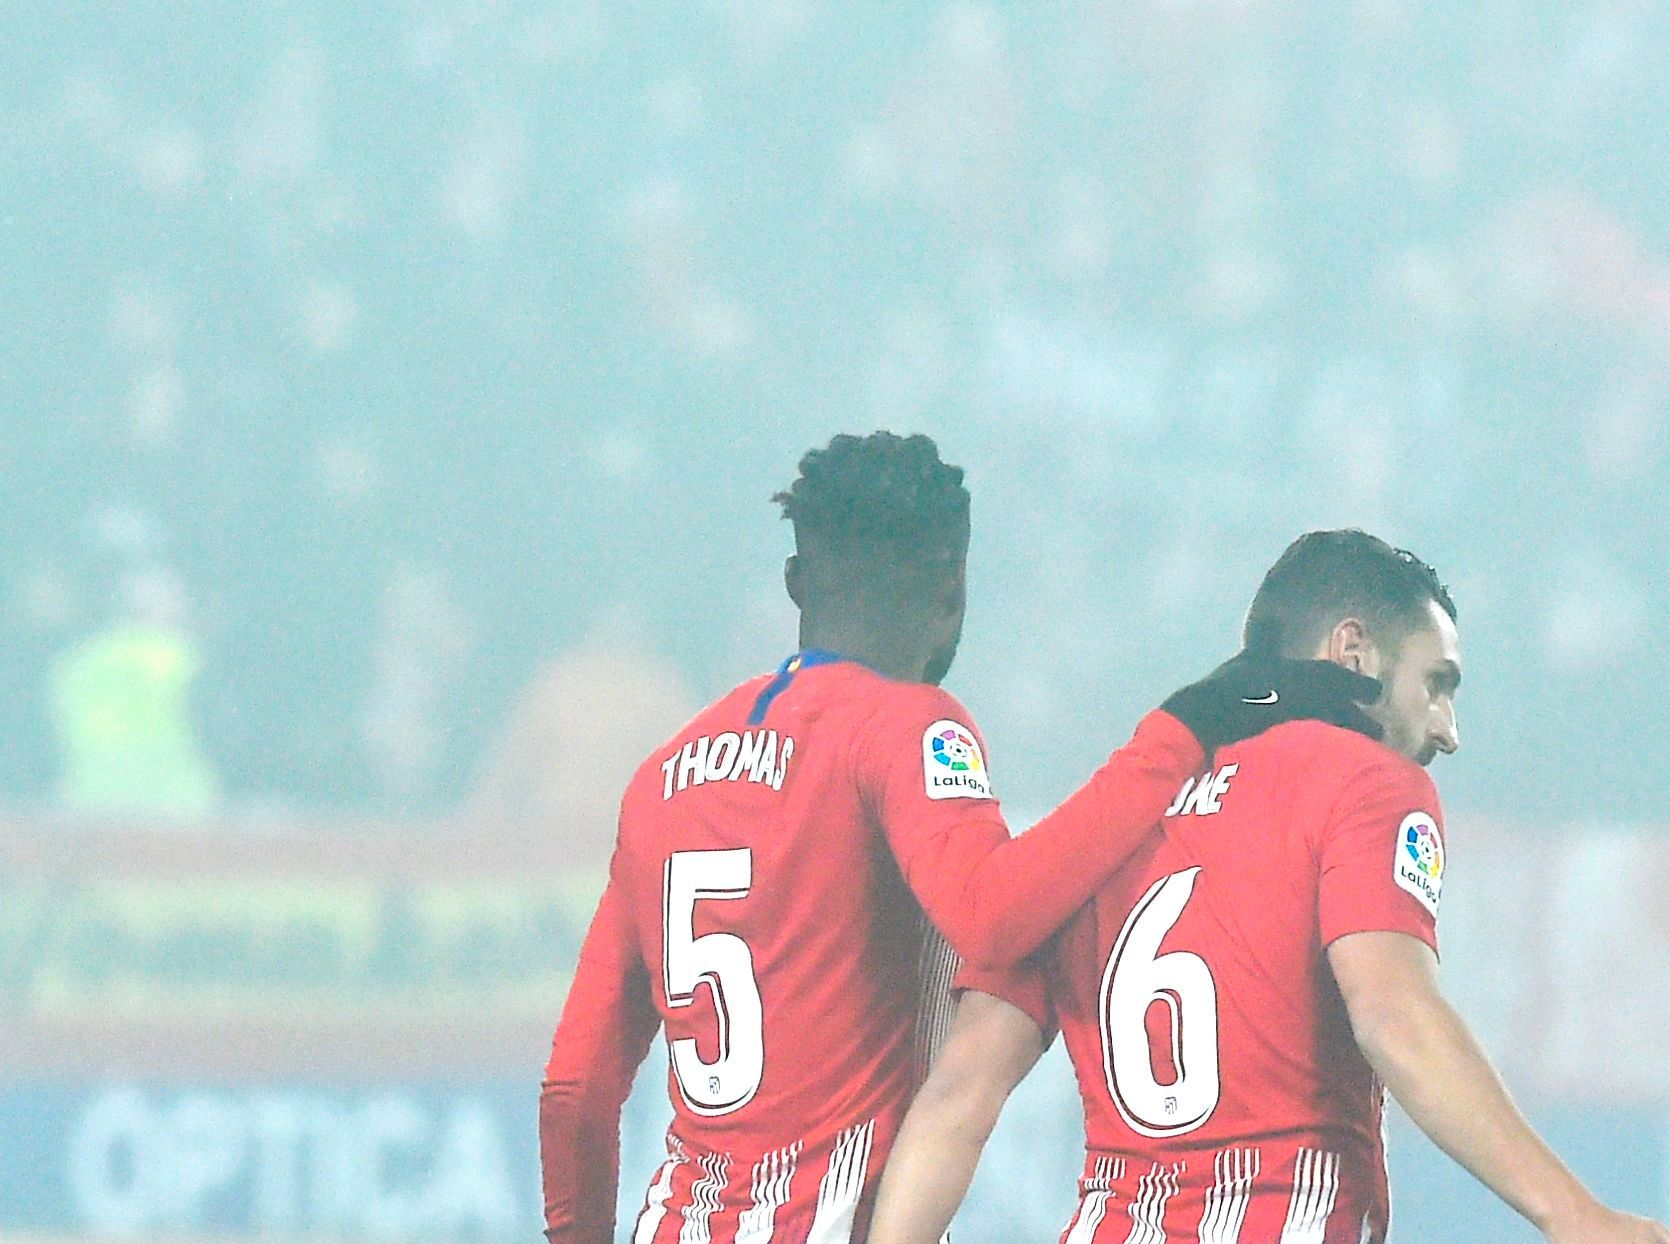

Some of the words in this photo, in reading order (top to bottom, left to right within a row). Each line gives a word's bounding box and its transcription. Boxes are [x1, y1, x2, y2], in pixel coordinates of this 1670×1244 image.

[661, 728, 796, 801] THOMAS
[933, 774, 985, 794] LaLiga
[662, 847, 764, 1117] 5
[1099, 866, 1221, 1138] 6
